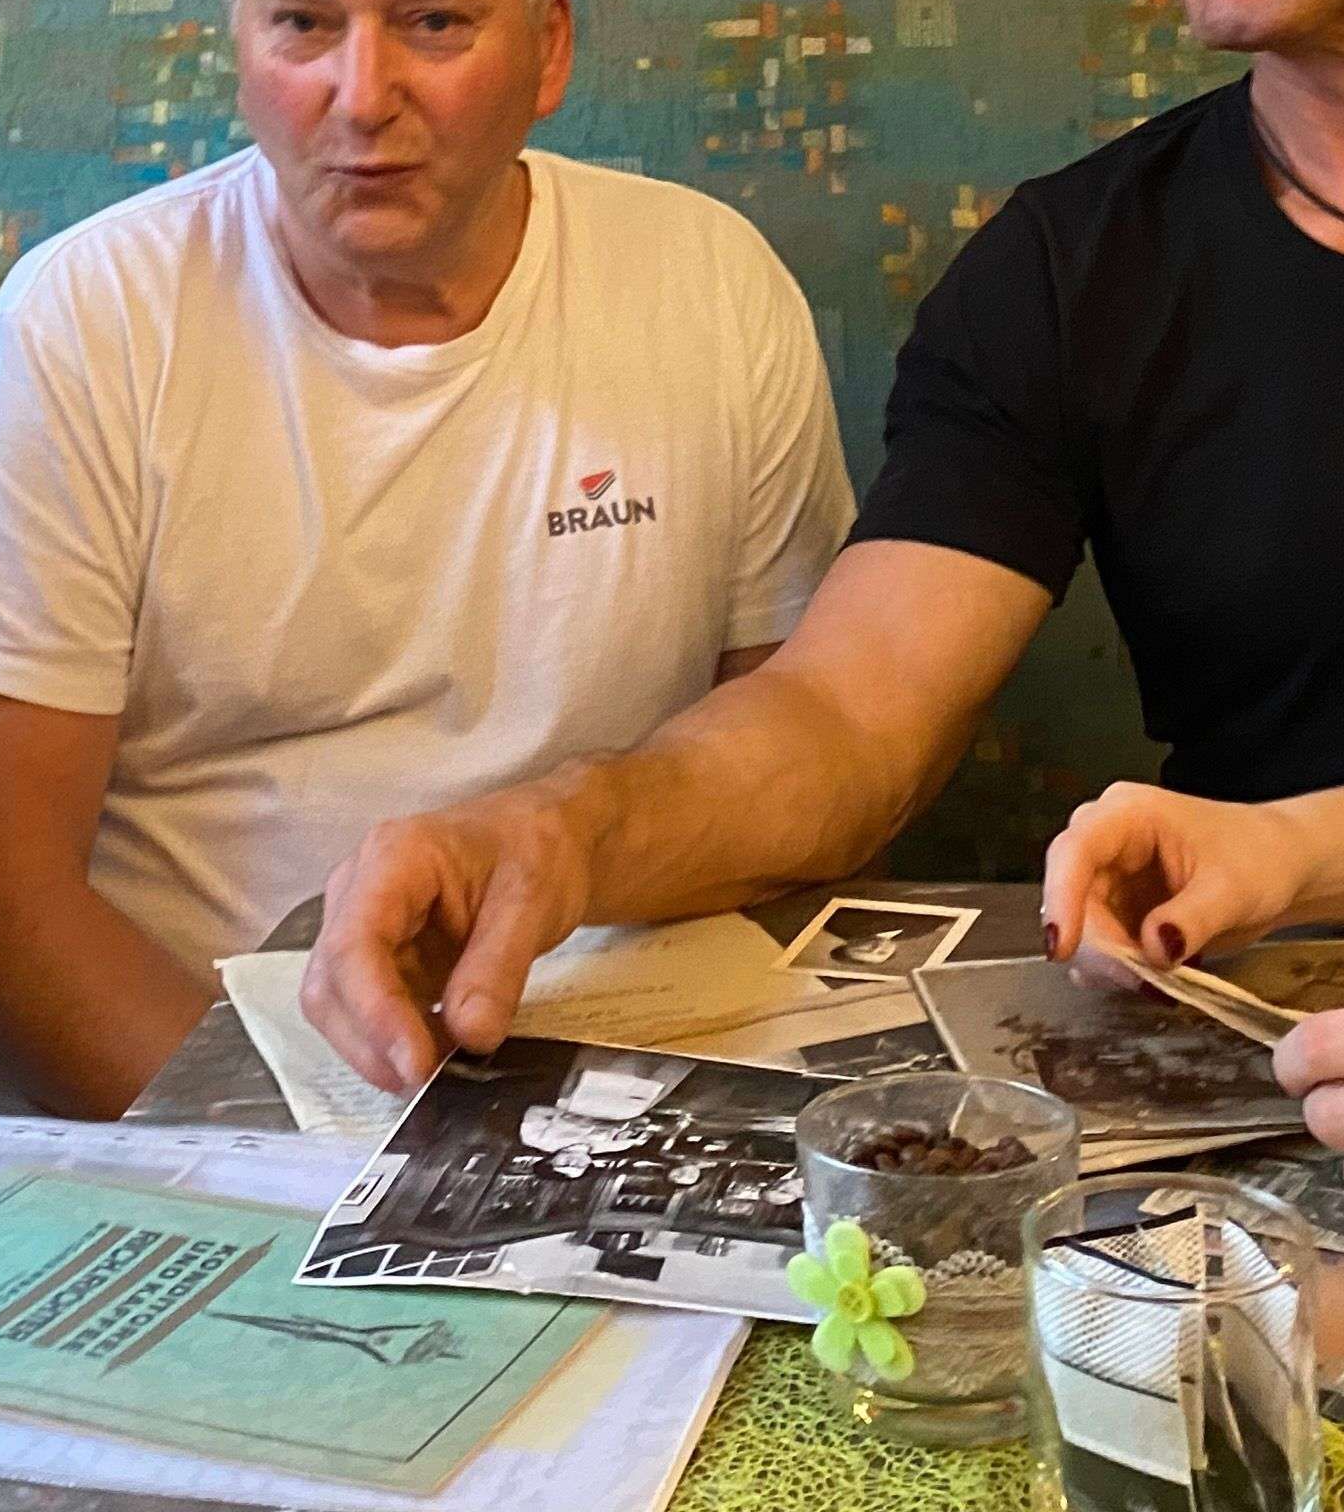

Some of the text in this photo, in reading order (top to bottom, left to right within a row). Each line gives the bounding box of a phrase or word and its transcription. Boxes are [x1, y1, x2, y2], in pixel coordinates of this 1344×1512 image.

[547, 496, 656, 537] BRAUN
[160, 1239, 217, 1282] UND
[58, 1278, 163, 1355] KAFFEE
[83, 1243, 242, 1359] KONDITOREI
